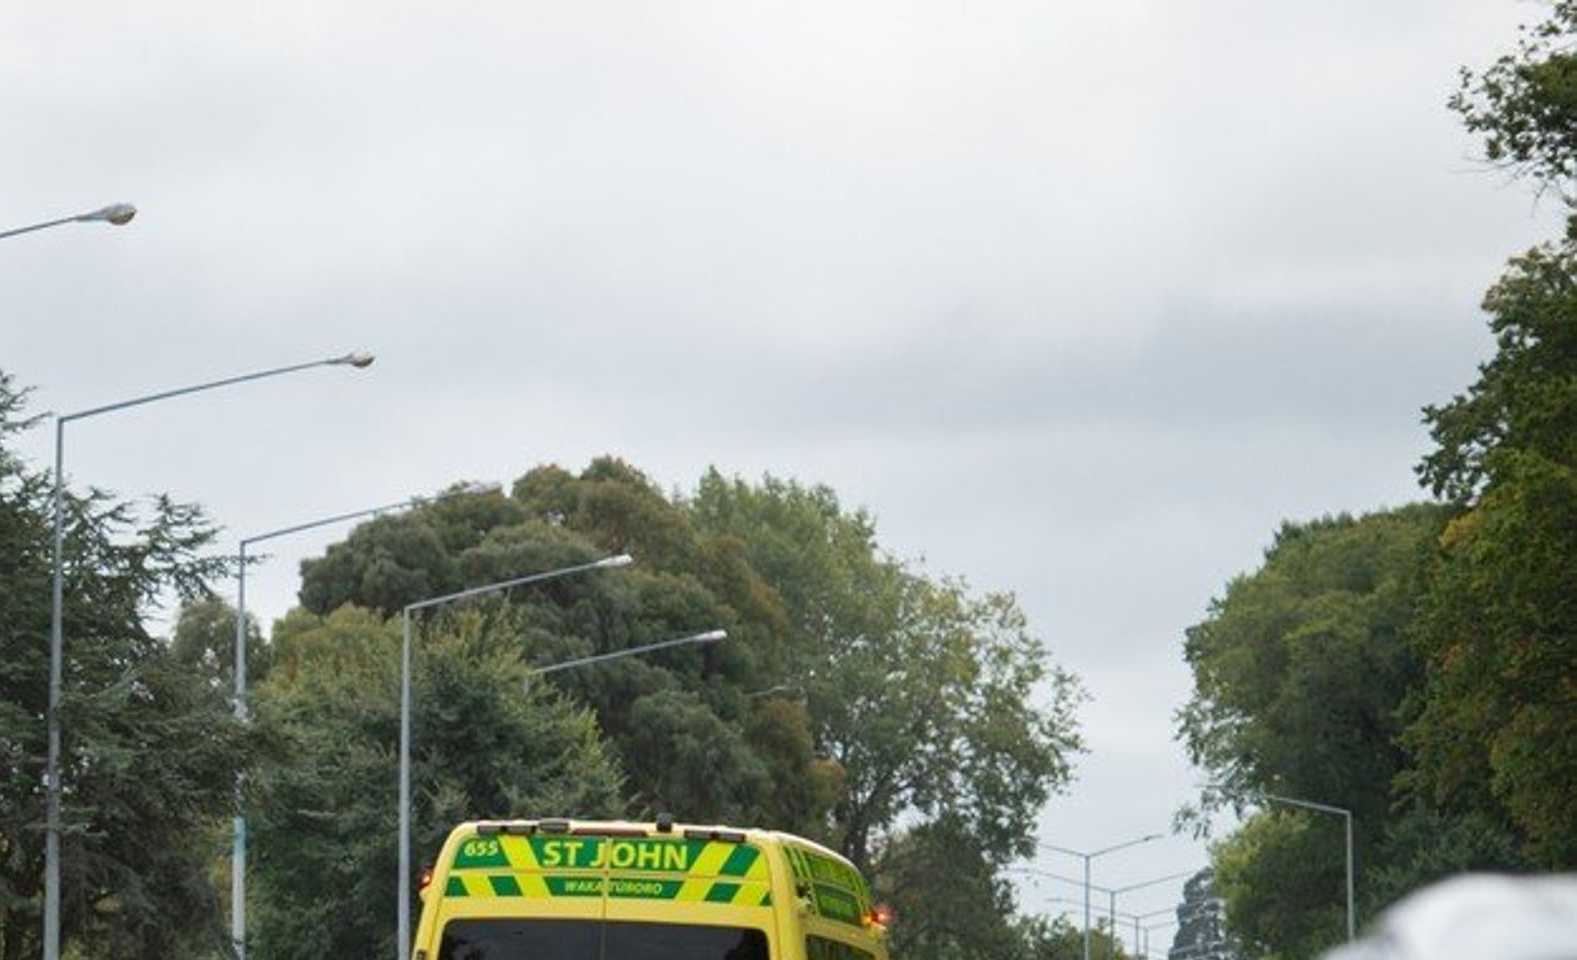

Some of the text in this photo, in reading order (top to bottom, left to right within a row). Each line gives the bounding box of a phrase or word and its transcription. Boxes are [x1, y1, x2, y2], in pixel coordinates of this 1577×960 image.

[464, 841, 498, 856] 655
[543, 841, 687, 870] ST JOHN
